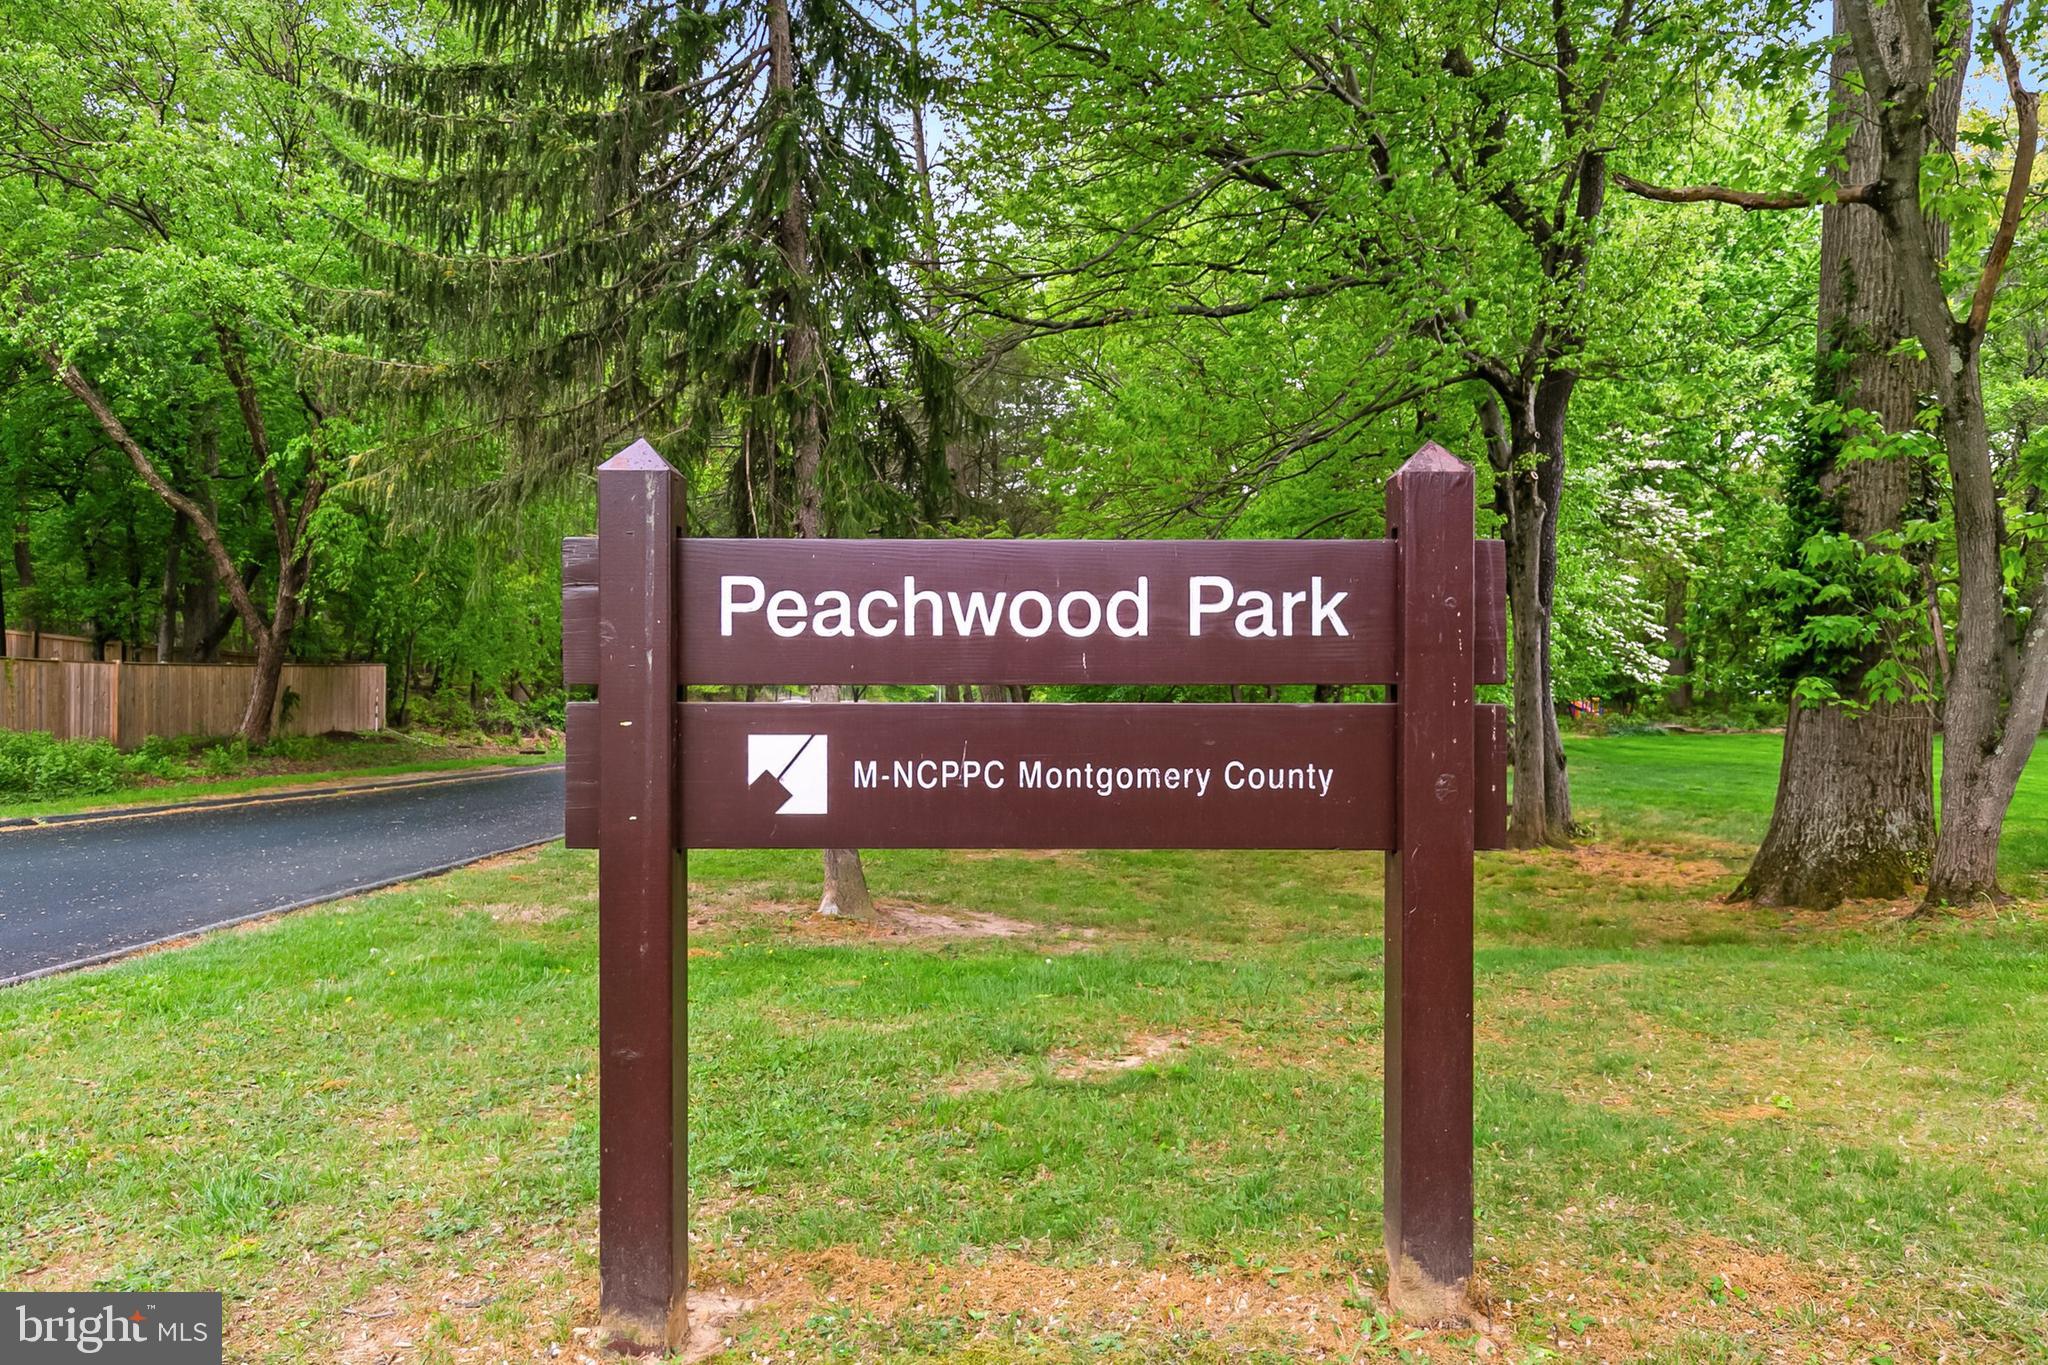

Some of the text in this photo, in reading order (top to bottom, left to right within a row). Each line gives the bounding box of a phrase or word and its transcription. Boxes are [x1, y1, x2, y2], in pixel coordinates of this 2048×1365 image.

[720, 575, 1350, 638] Peachwood Park
[853, 759, 1334, 797] M-NCPPC Montgomery County
